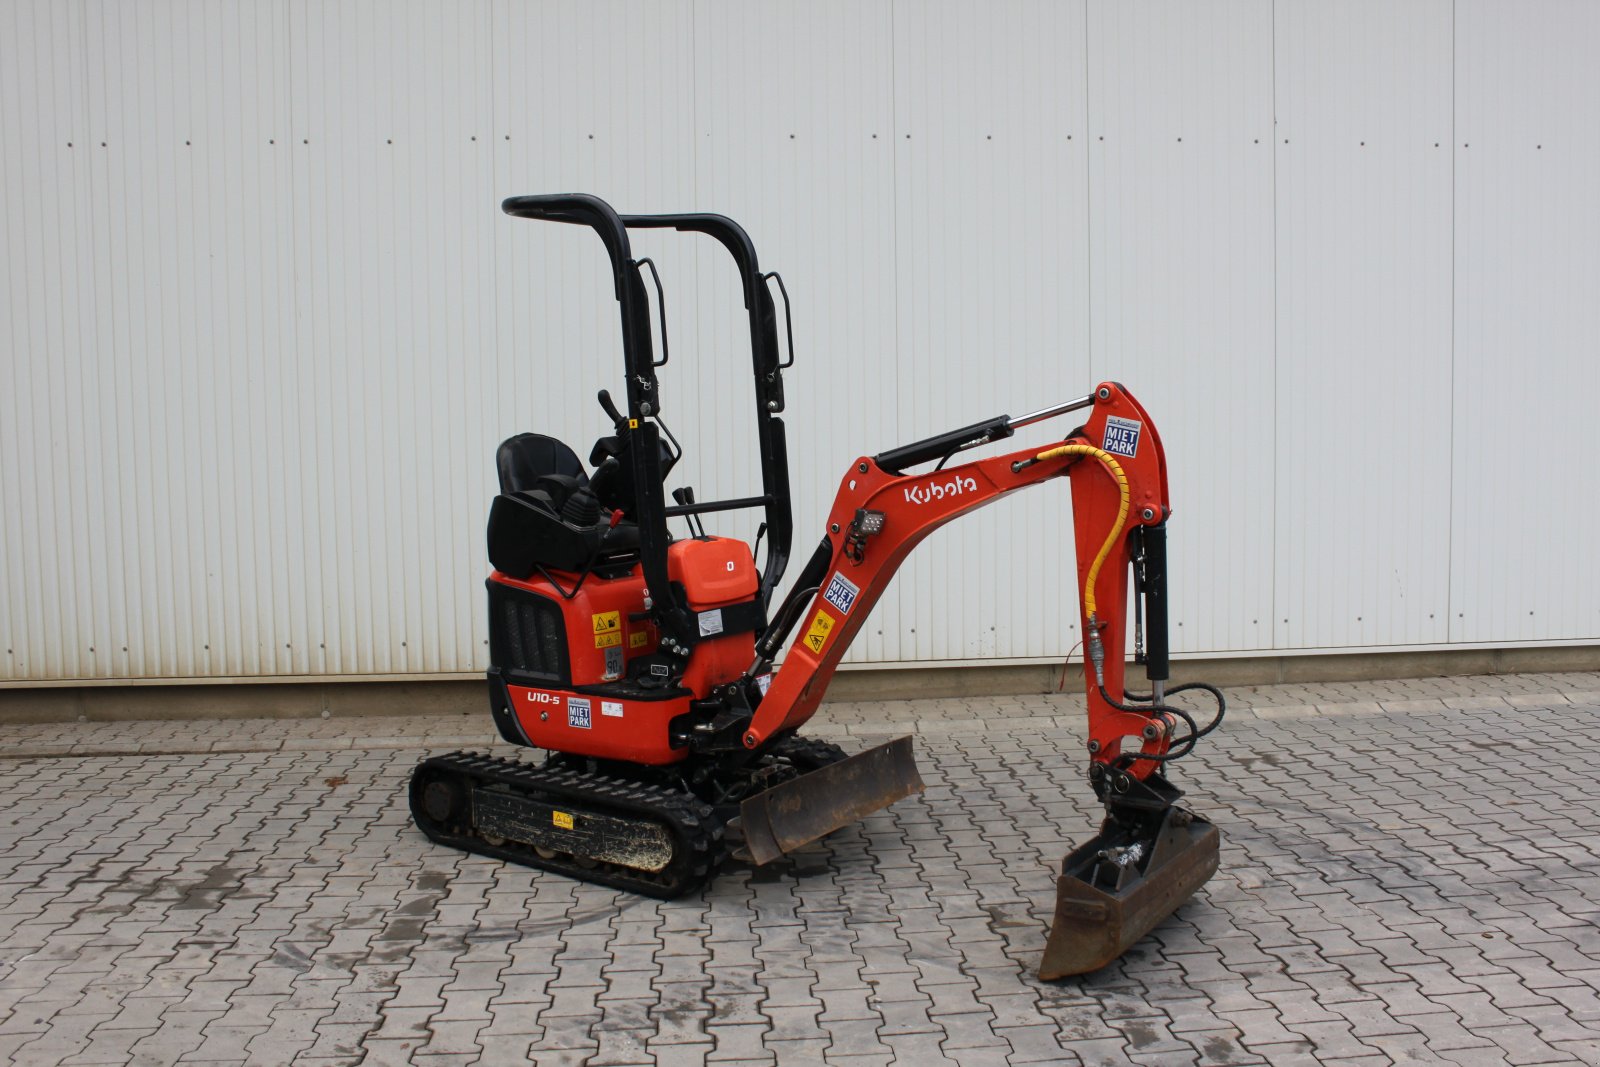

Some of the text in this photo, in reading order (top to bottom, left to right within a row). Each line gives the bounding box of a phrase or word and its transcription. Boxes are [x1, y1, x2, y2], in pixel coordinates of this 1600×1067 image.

[1107, 427, 1137, 442] MIET
[1105, 439, 1134, 455] PARK
[904, 475, 977, 504] Kubota
[830, 581, 853, 602] MIET
[826, 589, 848, 611] PARK
[527, 691, 560, 705] U10-5
[569, 706, 589, 717] MIET
[570, 715, 590, 727] PARK
